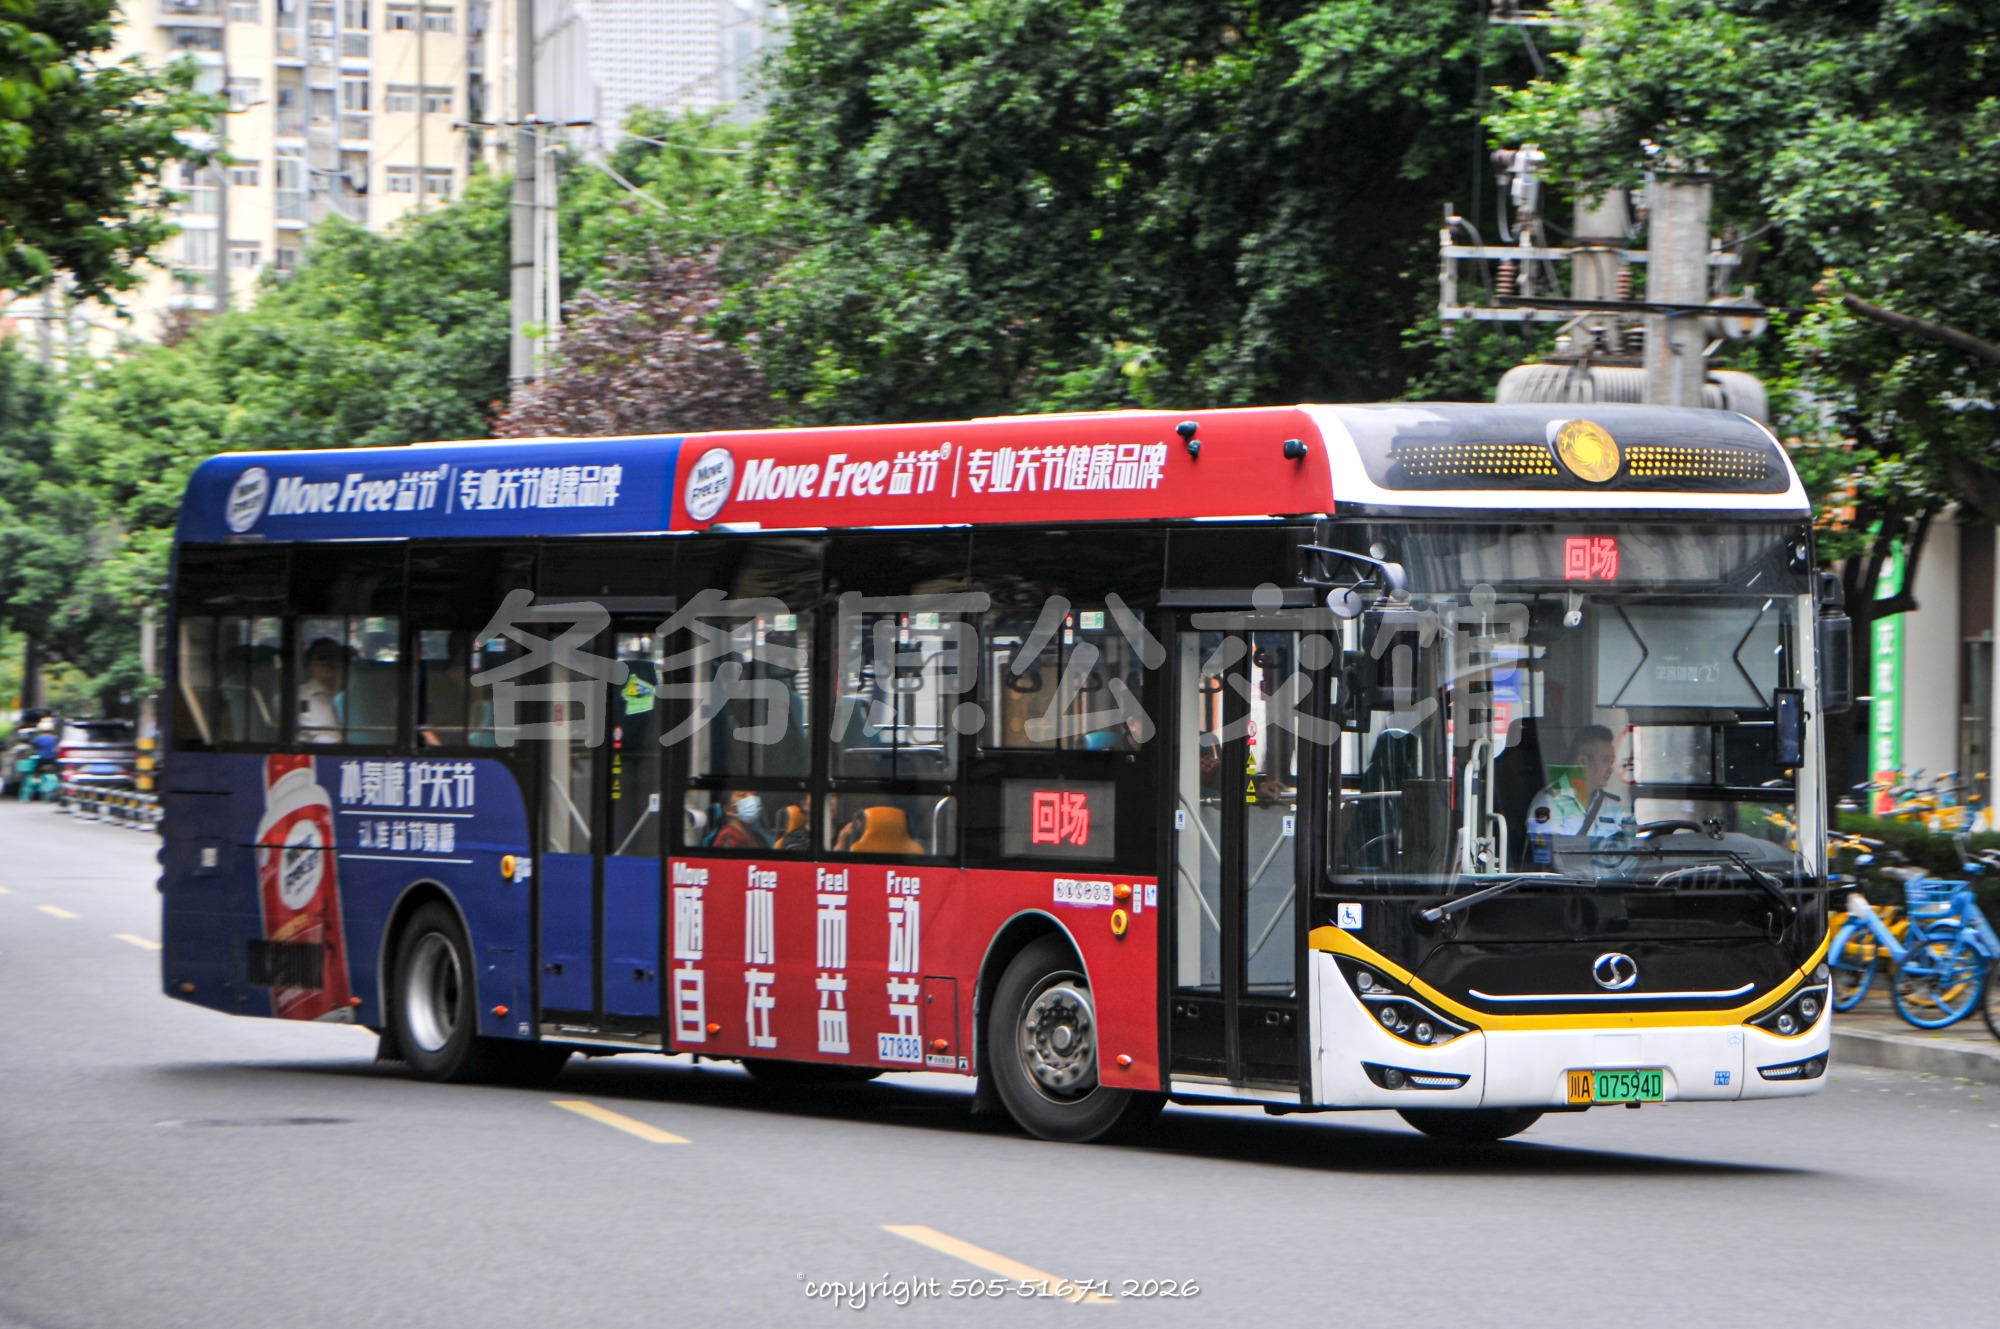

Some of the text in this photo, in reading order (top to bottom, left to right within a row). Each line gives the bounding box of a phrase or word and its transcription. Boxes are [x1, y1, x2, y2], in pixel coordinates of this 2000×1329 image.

[268, 476, 340, 516] Move
[336, 472, 398, 512] Free
[459, 463, 623, 510] 专业关节健康品牌
[735, 457, 820, 502] Move
[818, 453, 890, 498] Free
[967, 441, 1168, 493] 专业关节健康品牌
[1564, 536, 1618, 581] 回场
[408, 761, 476, 808] 护关节
[1031, 790, 1090, 846] 回场
[673, 862, 921, 895] Move Free Feel Free
[880, 1036, 921, 1060] 27838
[1570, 1074, 1661, 1098] 川A 07594D
